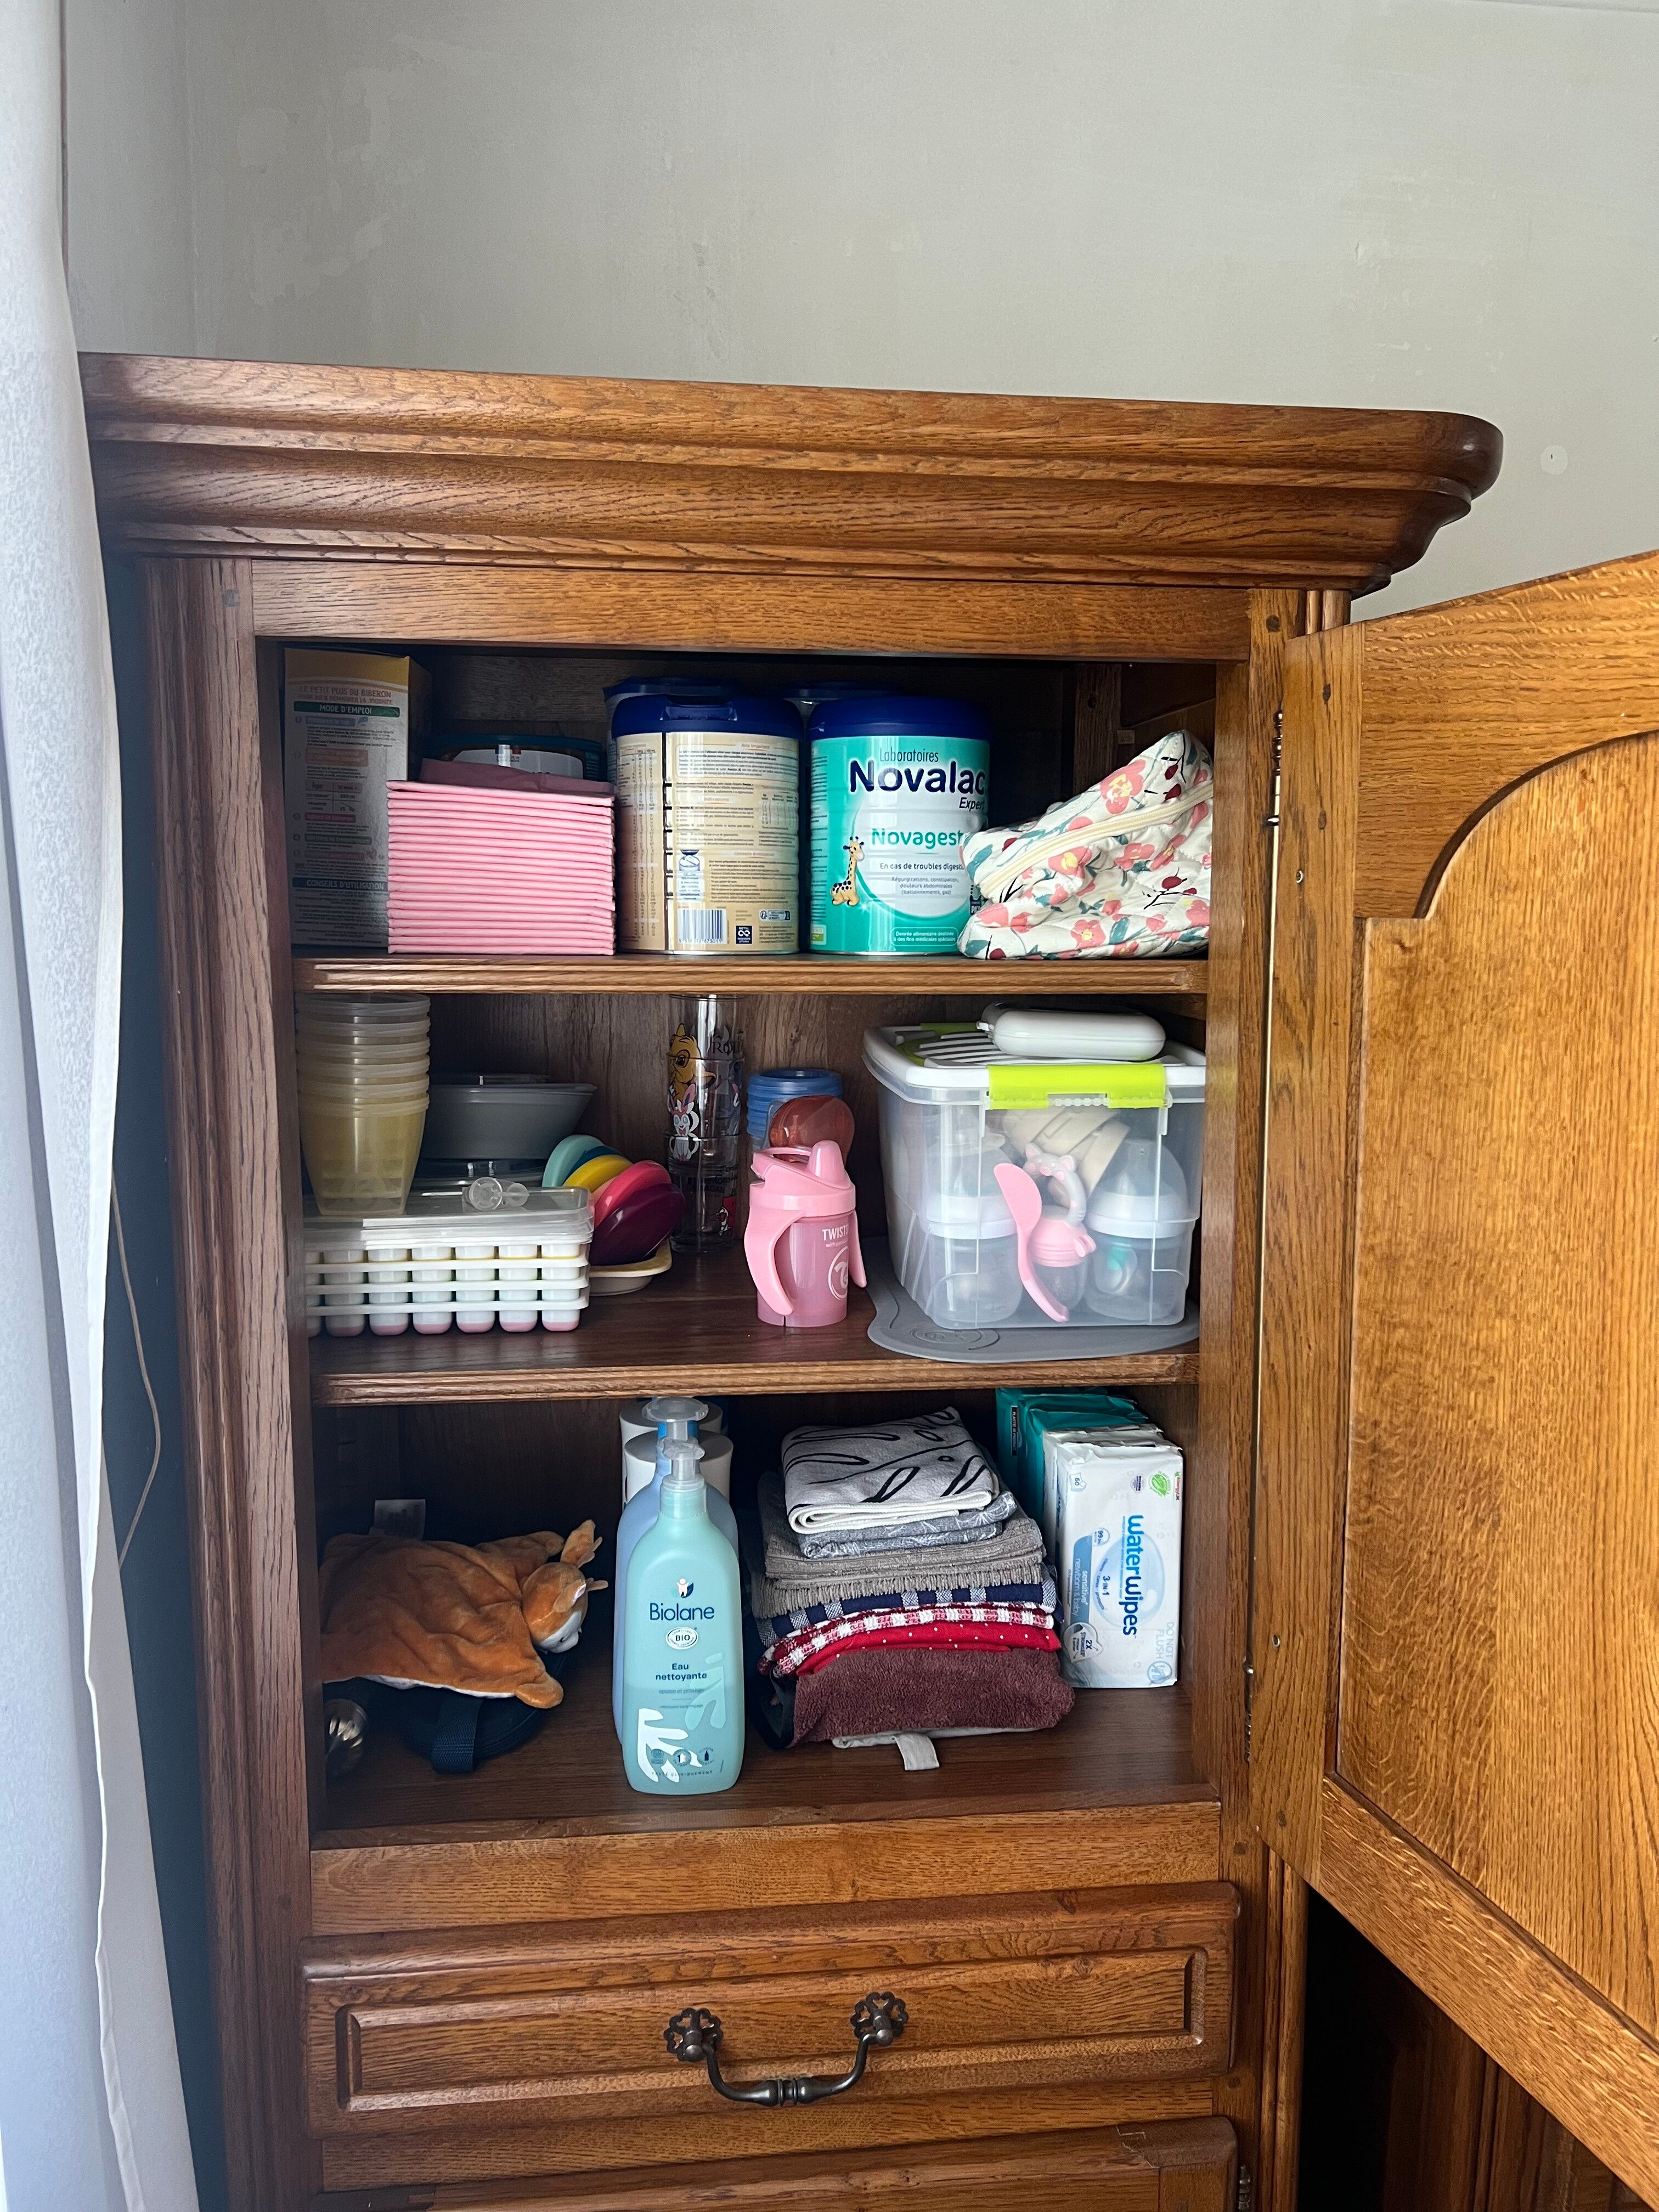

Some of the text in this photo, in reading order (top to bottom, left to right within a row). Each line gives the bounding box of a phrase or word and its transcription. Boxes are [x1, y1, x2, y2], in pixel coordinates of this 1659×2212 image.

[331, 686, 347, 695] PLUS
[361, 689, 392, 698] BIBERON
[319, 704, 373, 715] MODE D'EMPLOI
[879, 747, 939, 763] Laboratoires
[850, 759, 985, 795] Novalac
[1074, 1477, 1080, 1486] 60
[650, 1602, 715, 1621] Biolane
[1085, 1639, 1092, 1650] 2X
[1155, 1629, 1165, 1659] FLUSH
[1166, 1622, 1175, 1658] DO NOT
[656, 1672, 707, 1681] nettoyante
